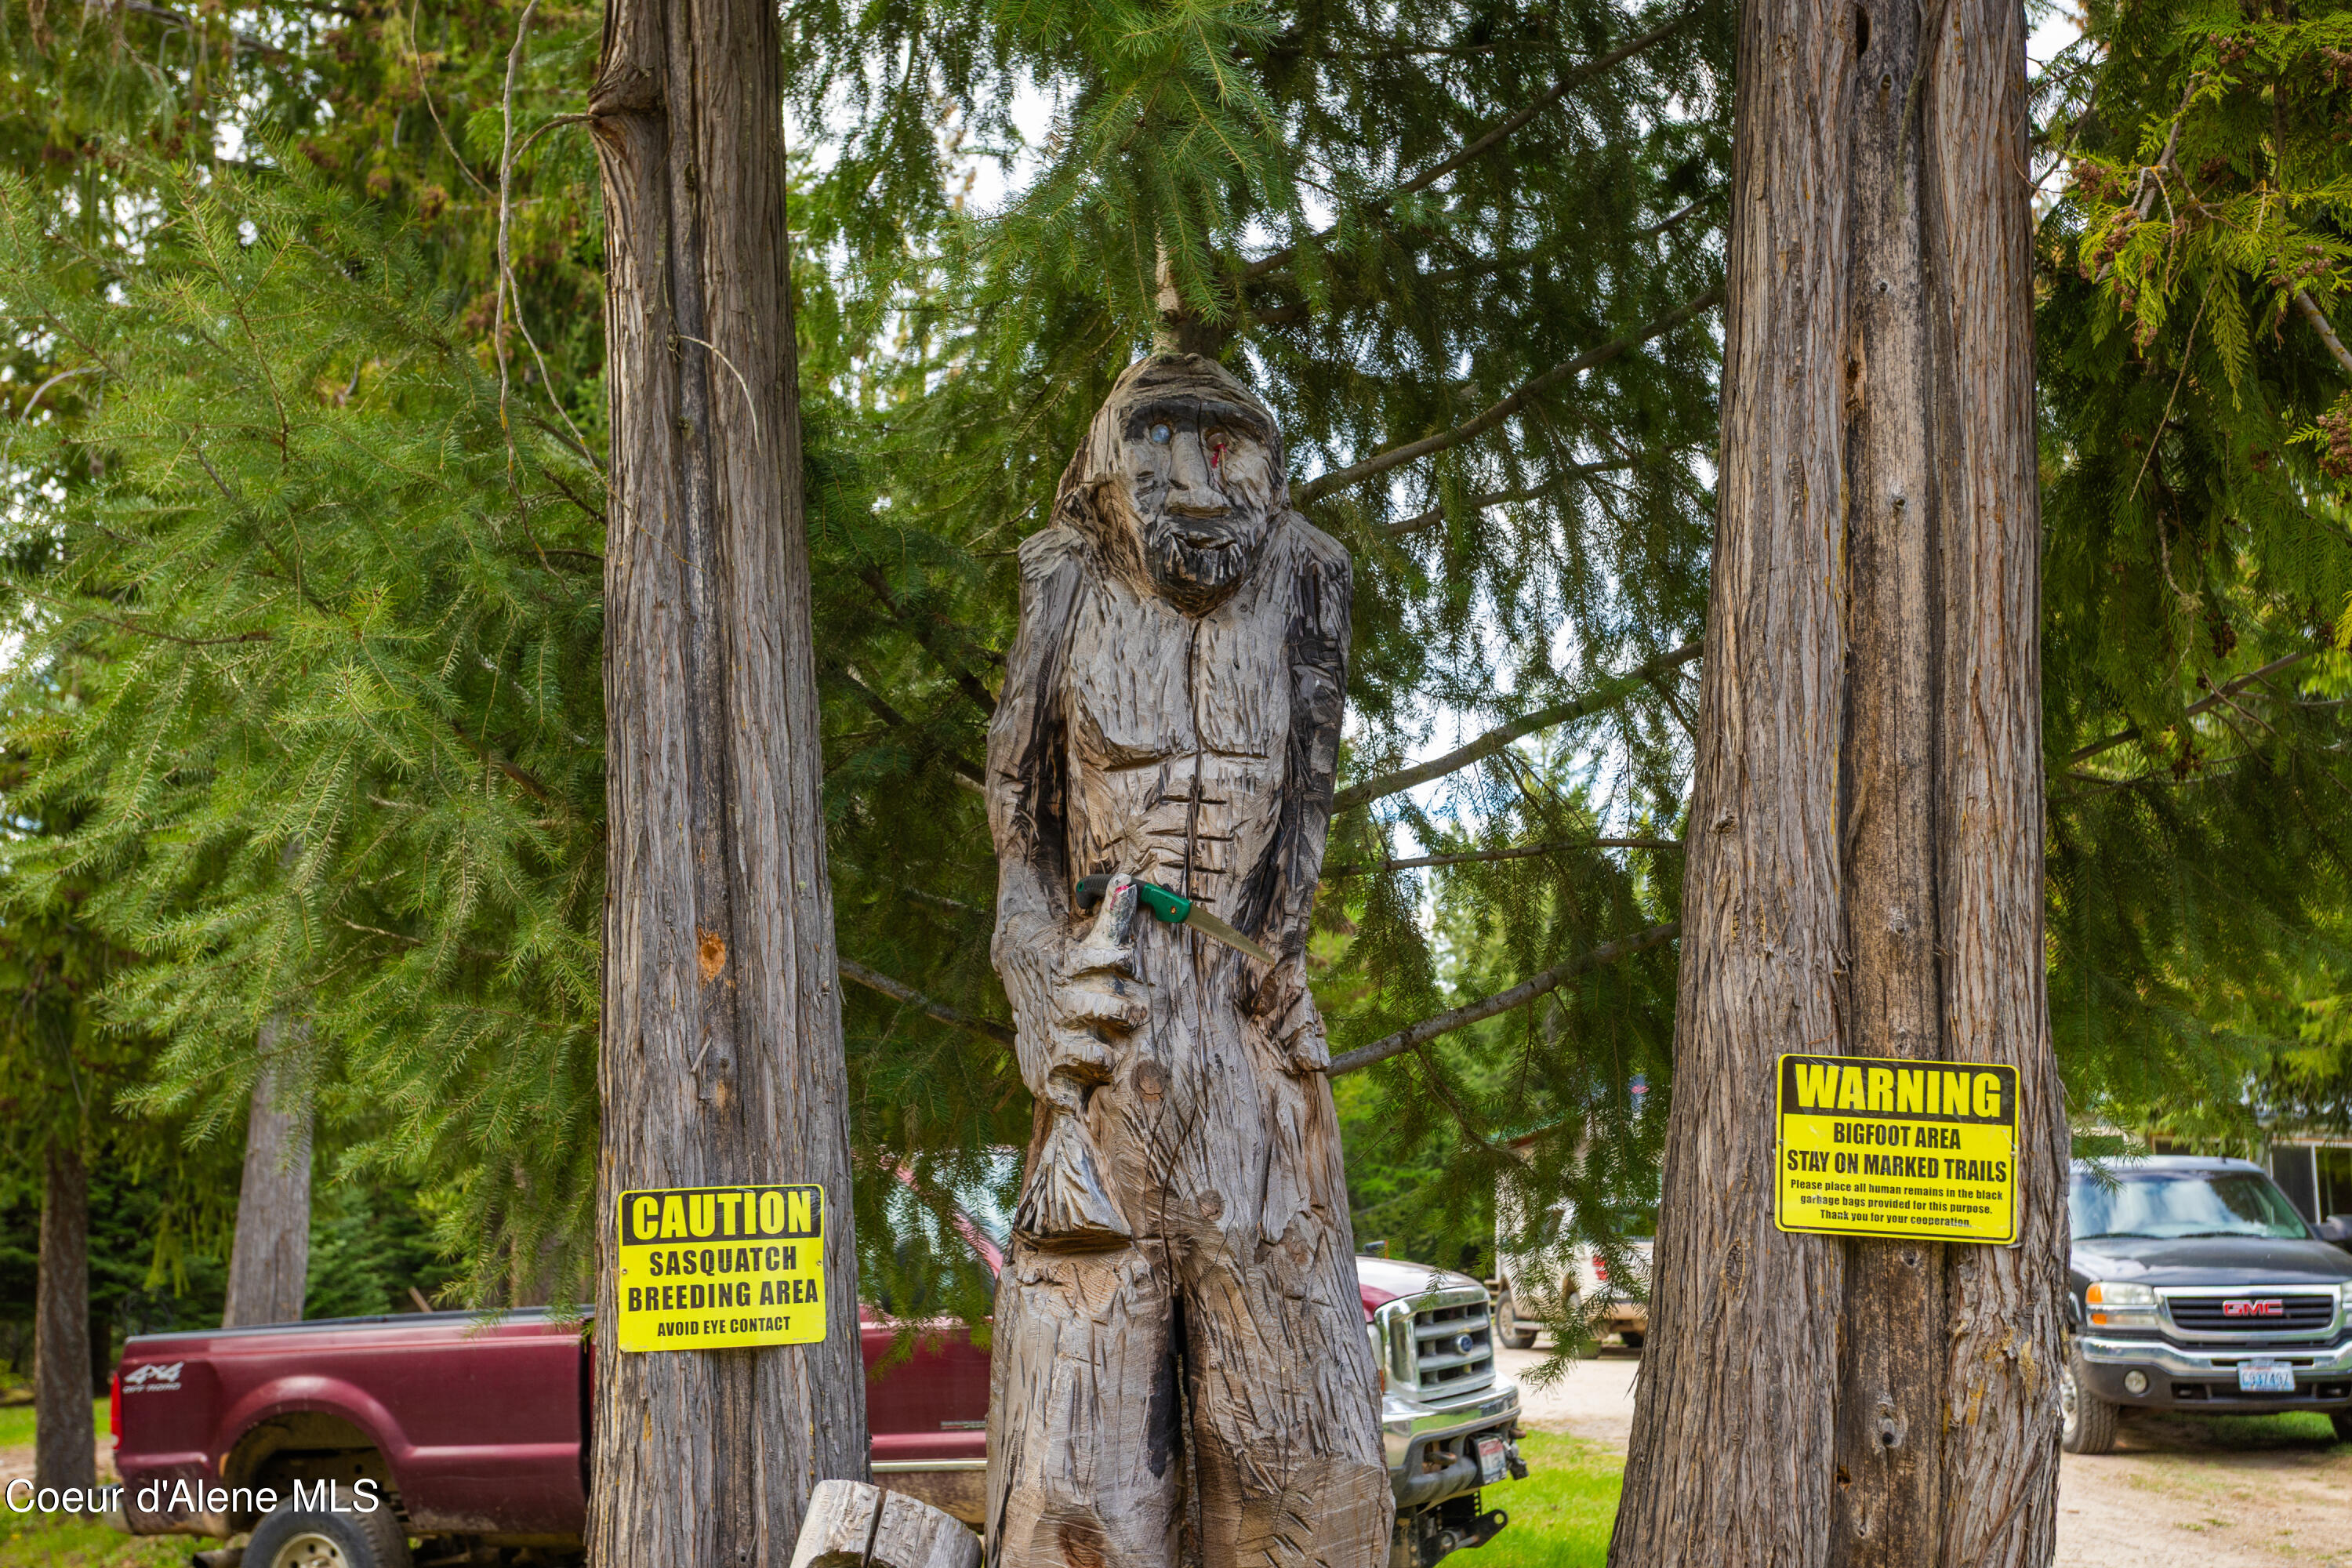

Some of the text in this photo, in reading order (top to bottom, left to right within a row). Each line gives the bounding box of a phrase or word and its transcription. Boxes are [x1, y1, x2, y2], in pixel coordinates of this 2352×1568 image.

[1795, 1064, 2001, 1117] WARNING
[1834, 1123, 1961, 1149] BIGFOOT AREA
[1788, 1149, 2006, 1182] STAY ON MARKED TRAILS
[1791, 1179, 2002, 1200] Please place all human remains in the black
[633, 1191, 811, 1240] CAUTION
[1800, 1195, 1993, 1214] garbage bags provided for this purpose.
[1820, 1210, 1972, 1228] Thank you for your cooperation.
[650, 1246, 797, 1276] SASQUATCH
[629, 1279, 818, 1311] BREEDING AREA
[2223, 1298, 2283, 1316] GMC
[658, 1316, 790, 1337] AVOID EYE CONTACT
